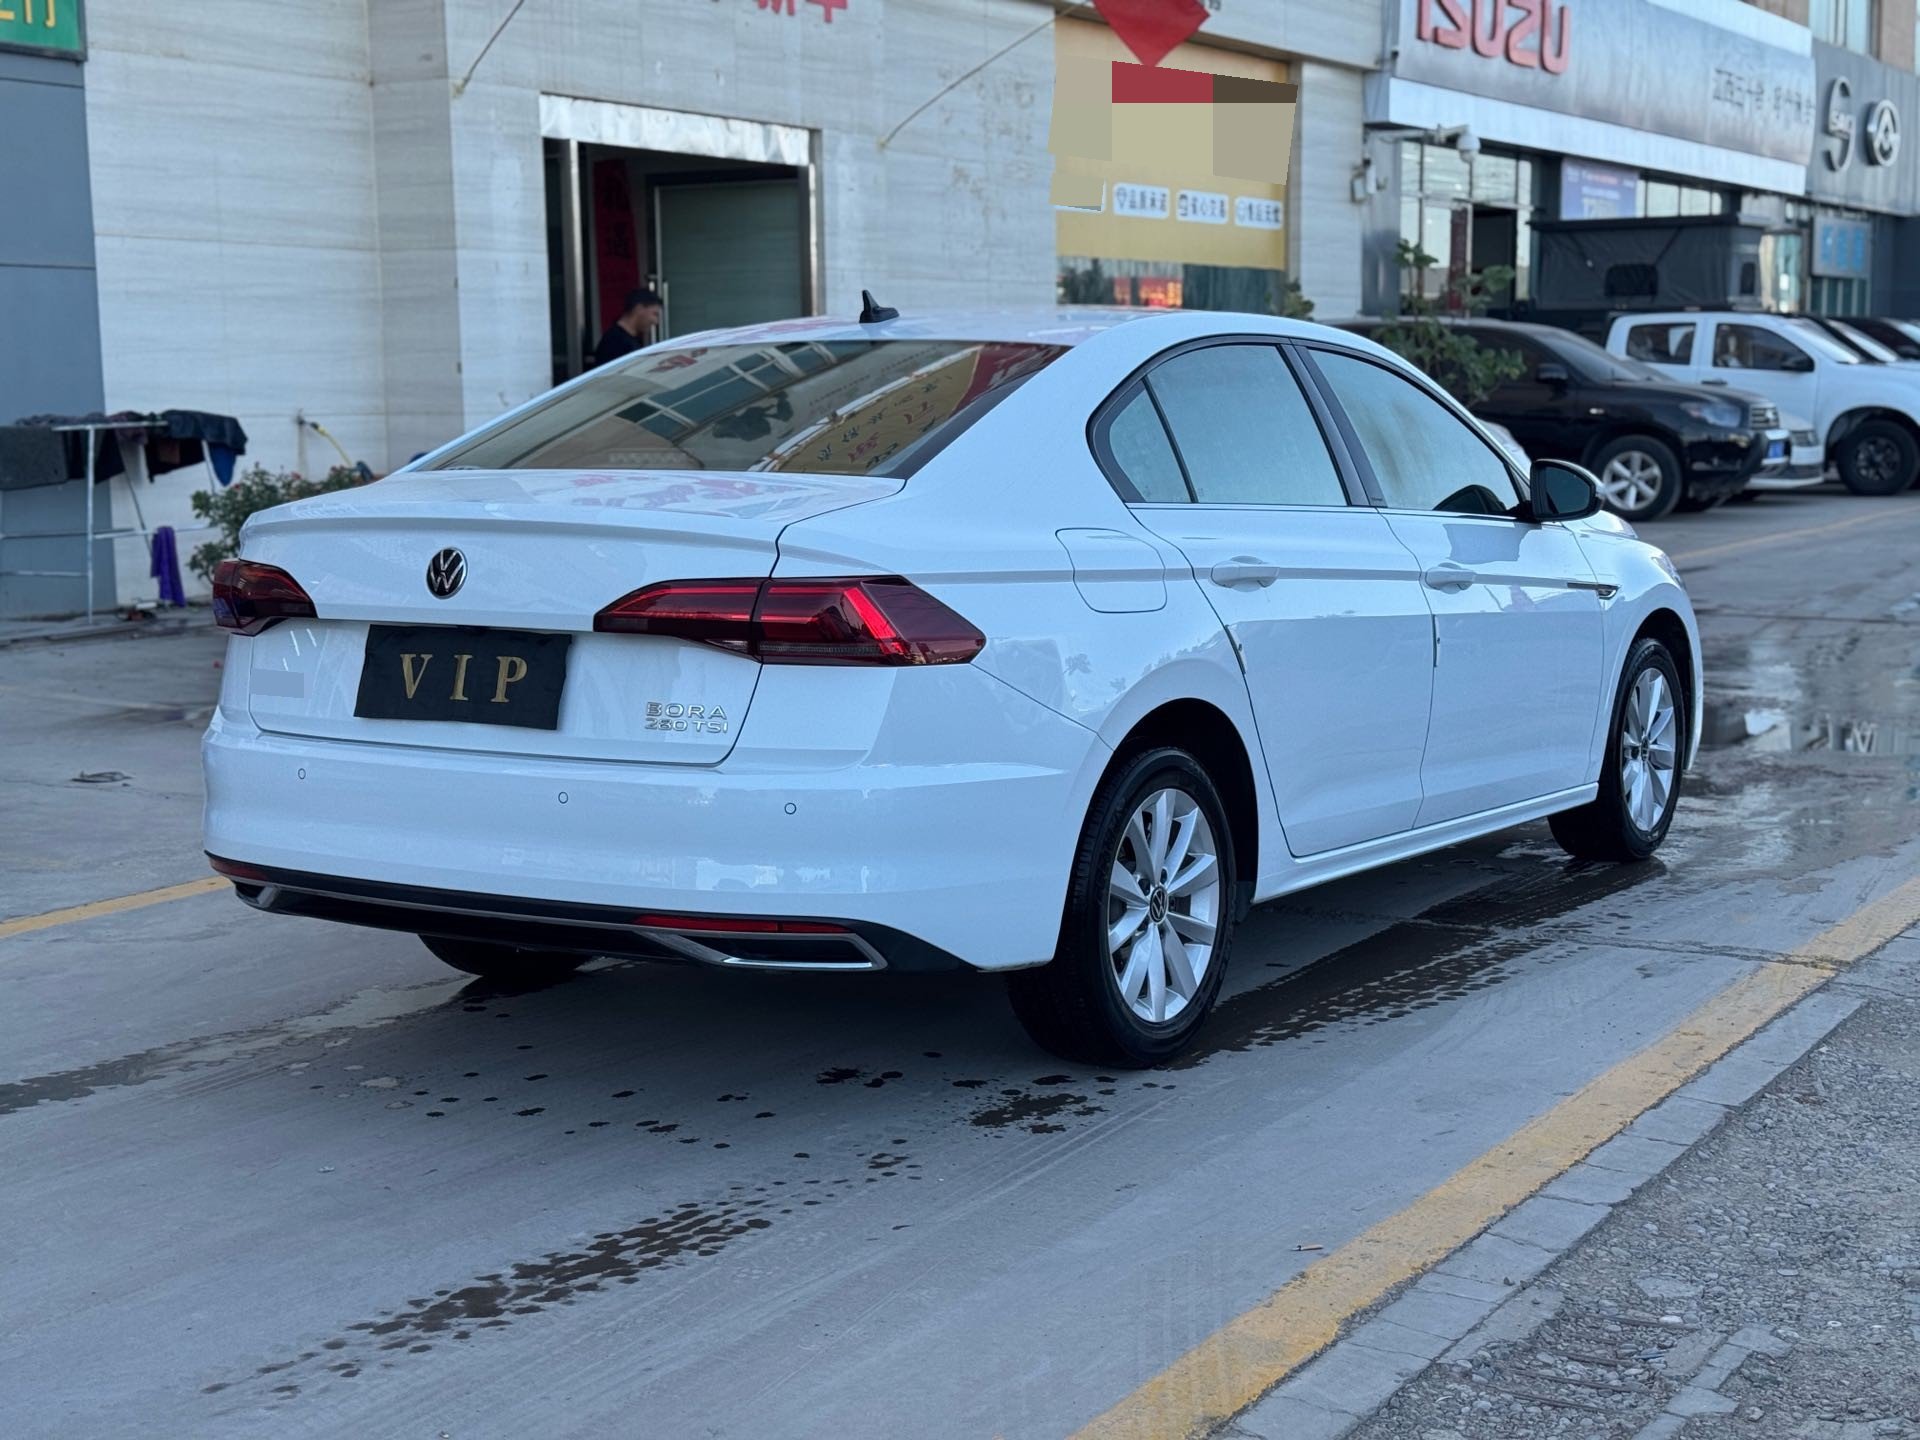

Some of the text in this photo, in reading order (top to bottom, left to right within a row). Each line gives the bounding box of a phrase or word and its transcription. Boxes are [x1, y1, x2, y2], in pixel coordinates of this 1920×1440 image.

[1417, 0, 1571, 75] ISUZU
[400, 653, 529, 703] VIP
[646, 701, 728, 720] BORA
